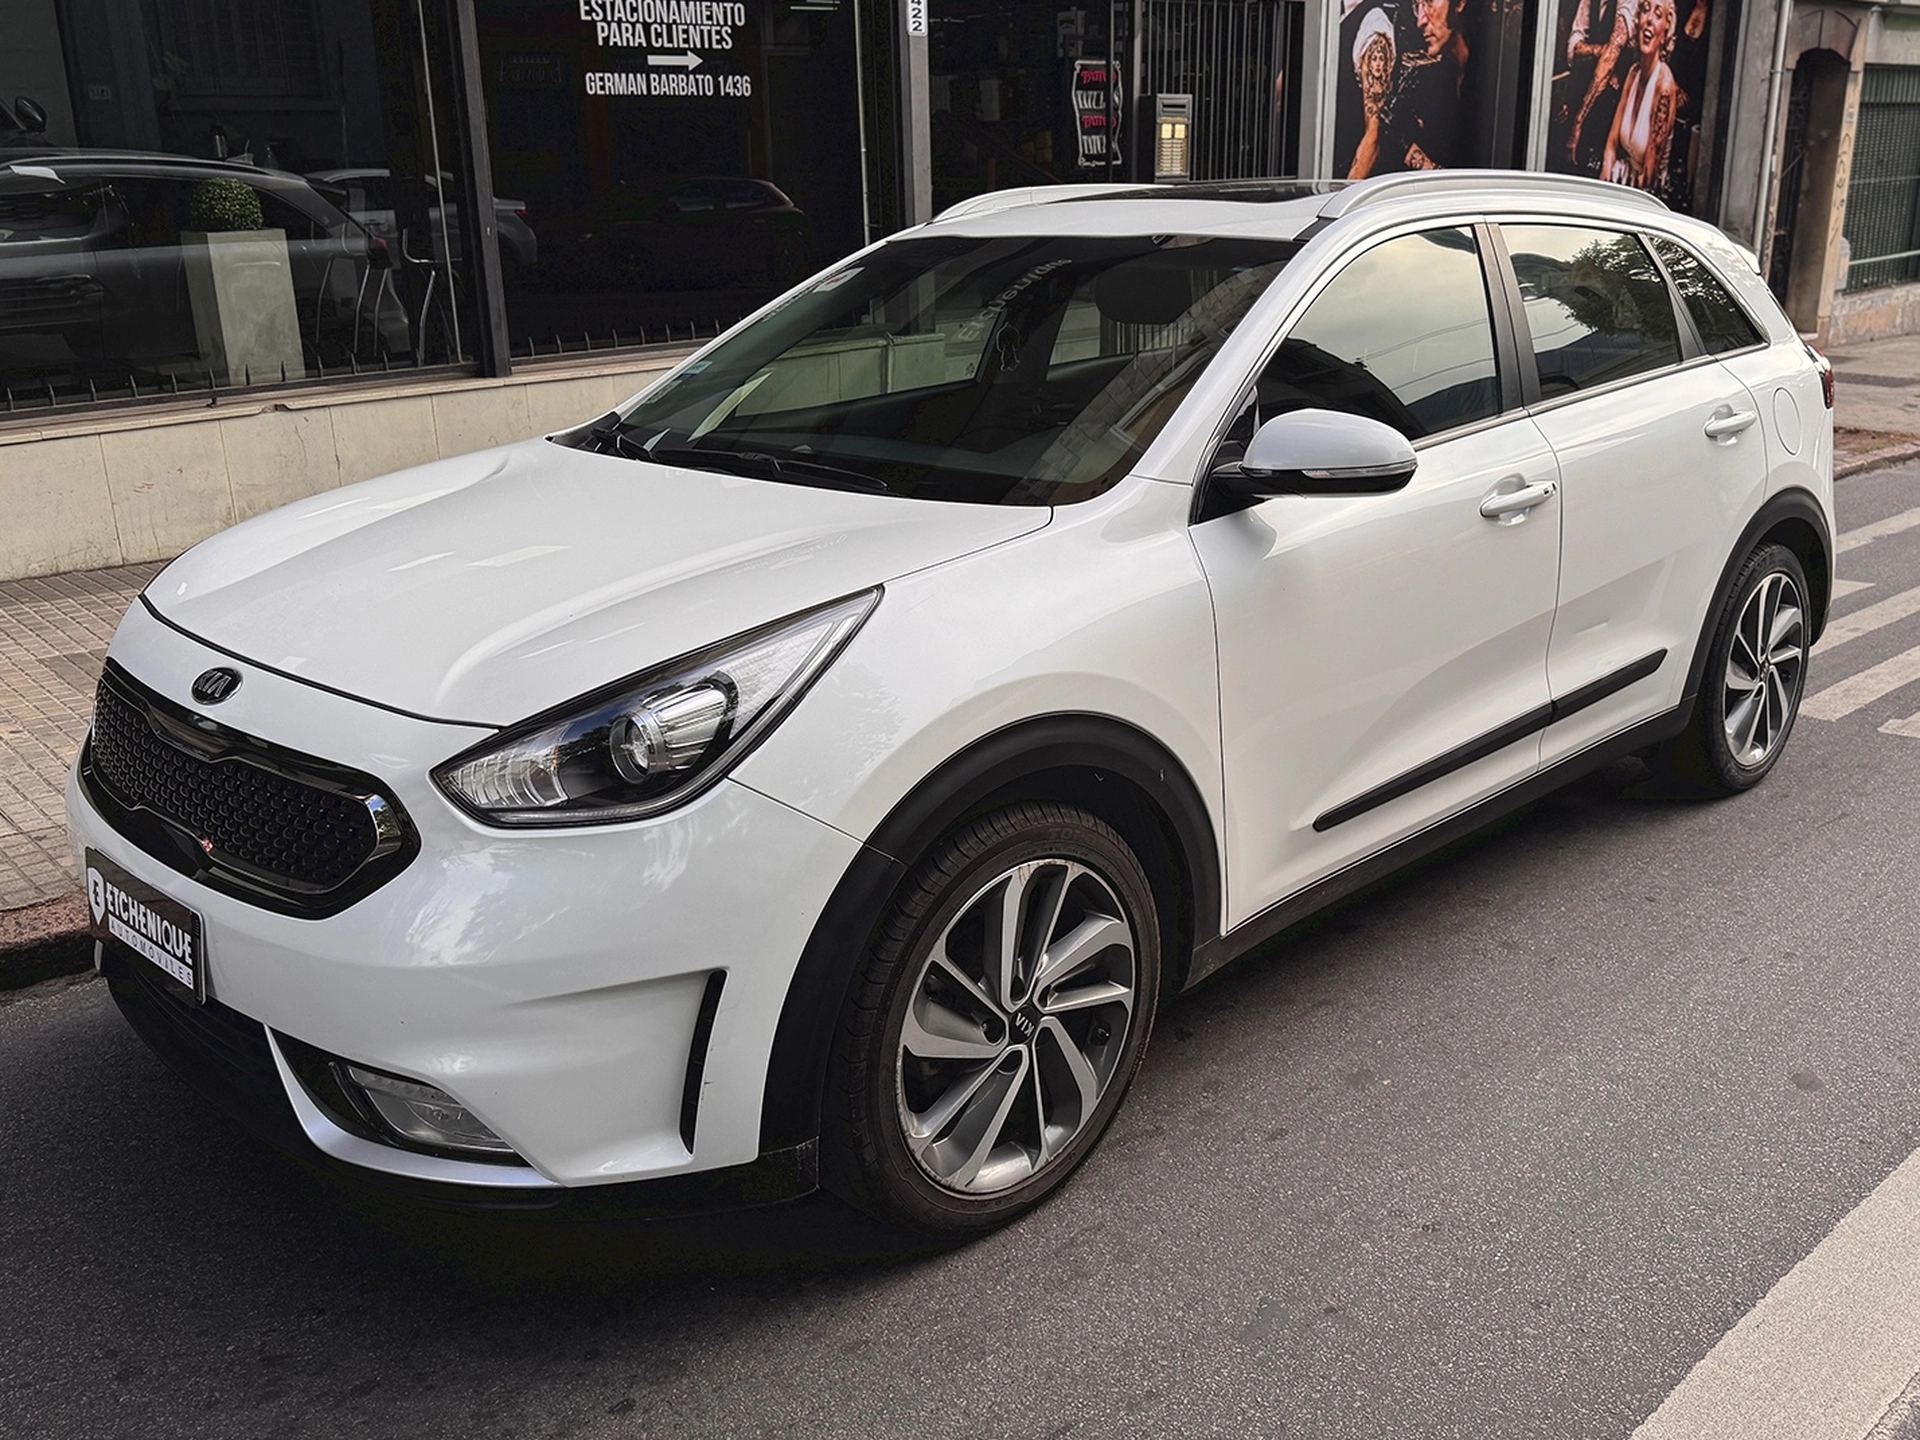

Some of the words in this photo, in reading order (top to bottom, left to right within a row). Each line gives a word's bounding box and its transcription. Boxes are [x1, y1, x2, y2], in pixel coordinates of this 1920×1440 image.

[580, 0, 745, 26] ESTACIONAMIENTO
[597, 22, 647, 47] PARA
[651, 24, 733, 49] CLIENTES
[585, 72, 647, 95] GERMAN
[651, 73, 714, 96] BARBATO
[718, 75, 752, 96] 1436
[194, 670, 232, 698] KIA
[105, 881, 193, 966] ETCHENIQUE
[110, 922, 193, 986] AUTOMOVILES
[1015, 1012, 1035, 1037] KIA
